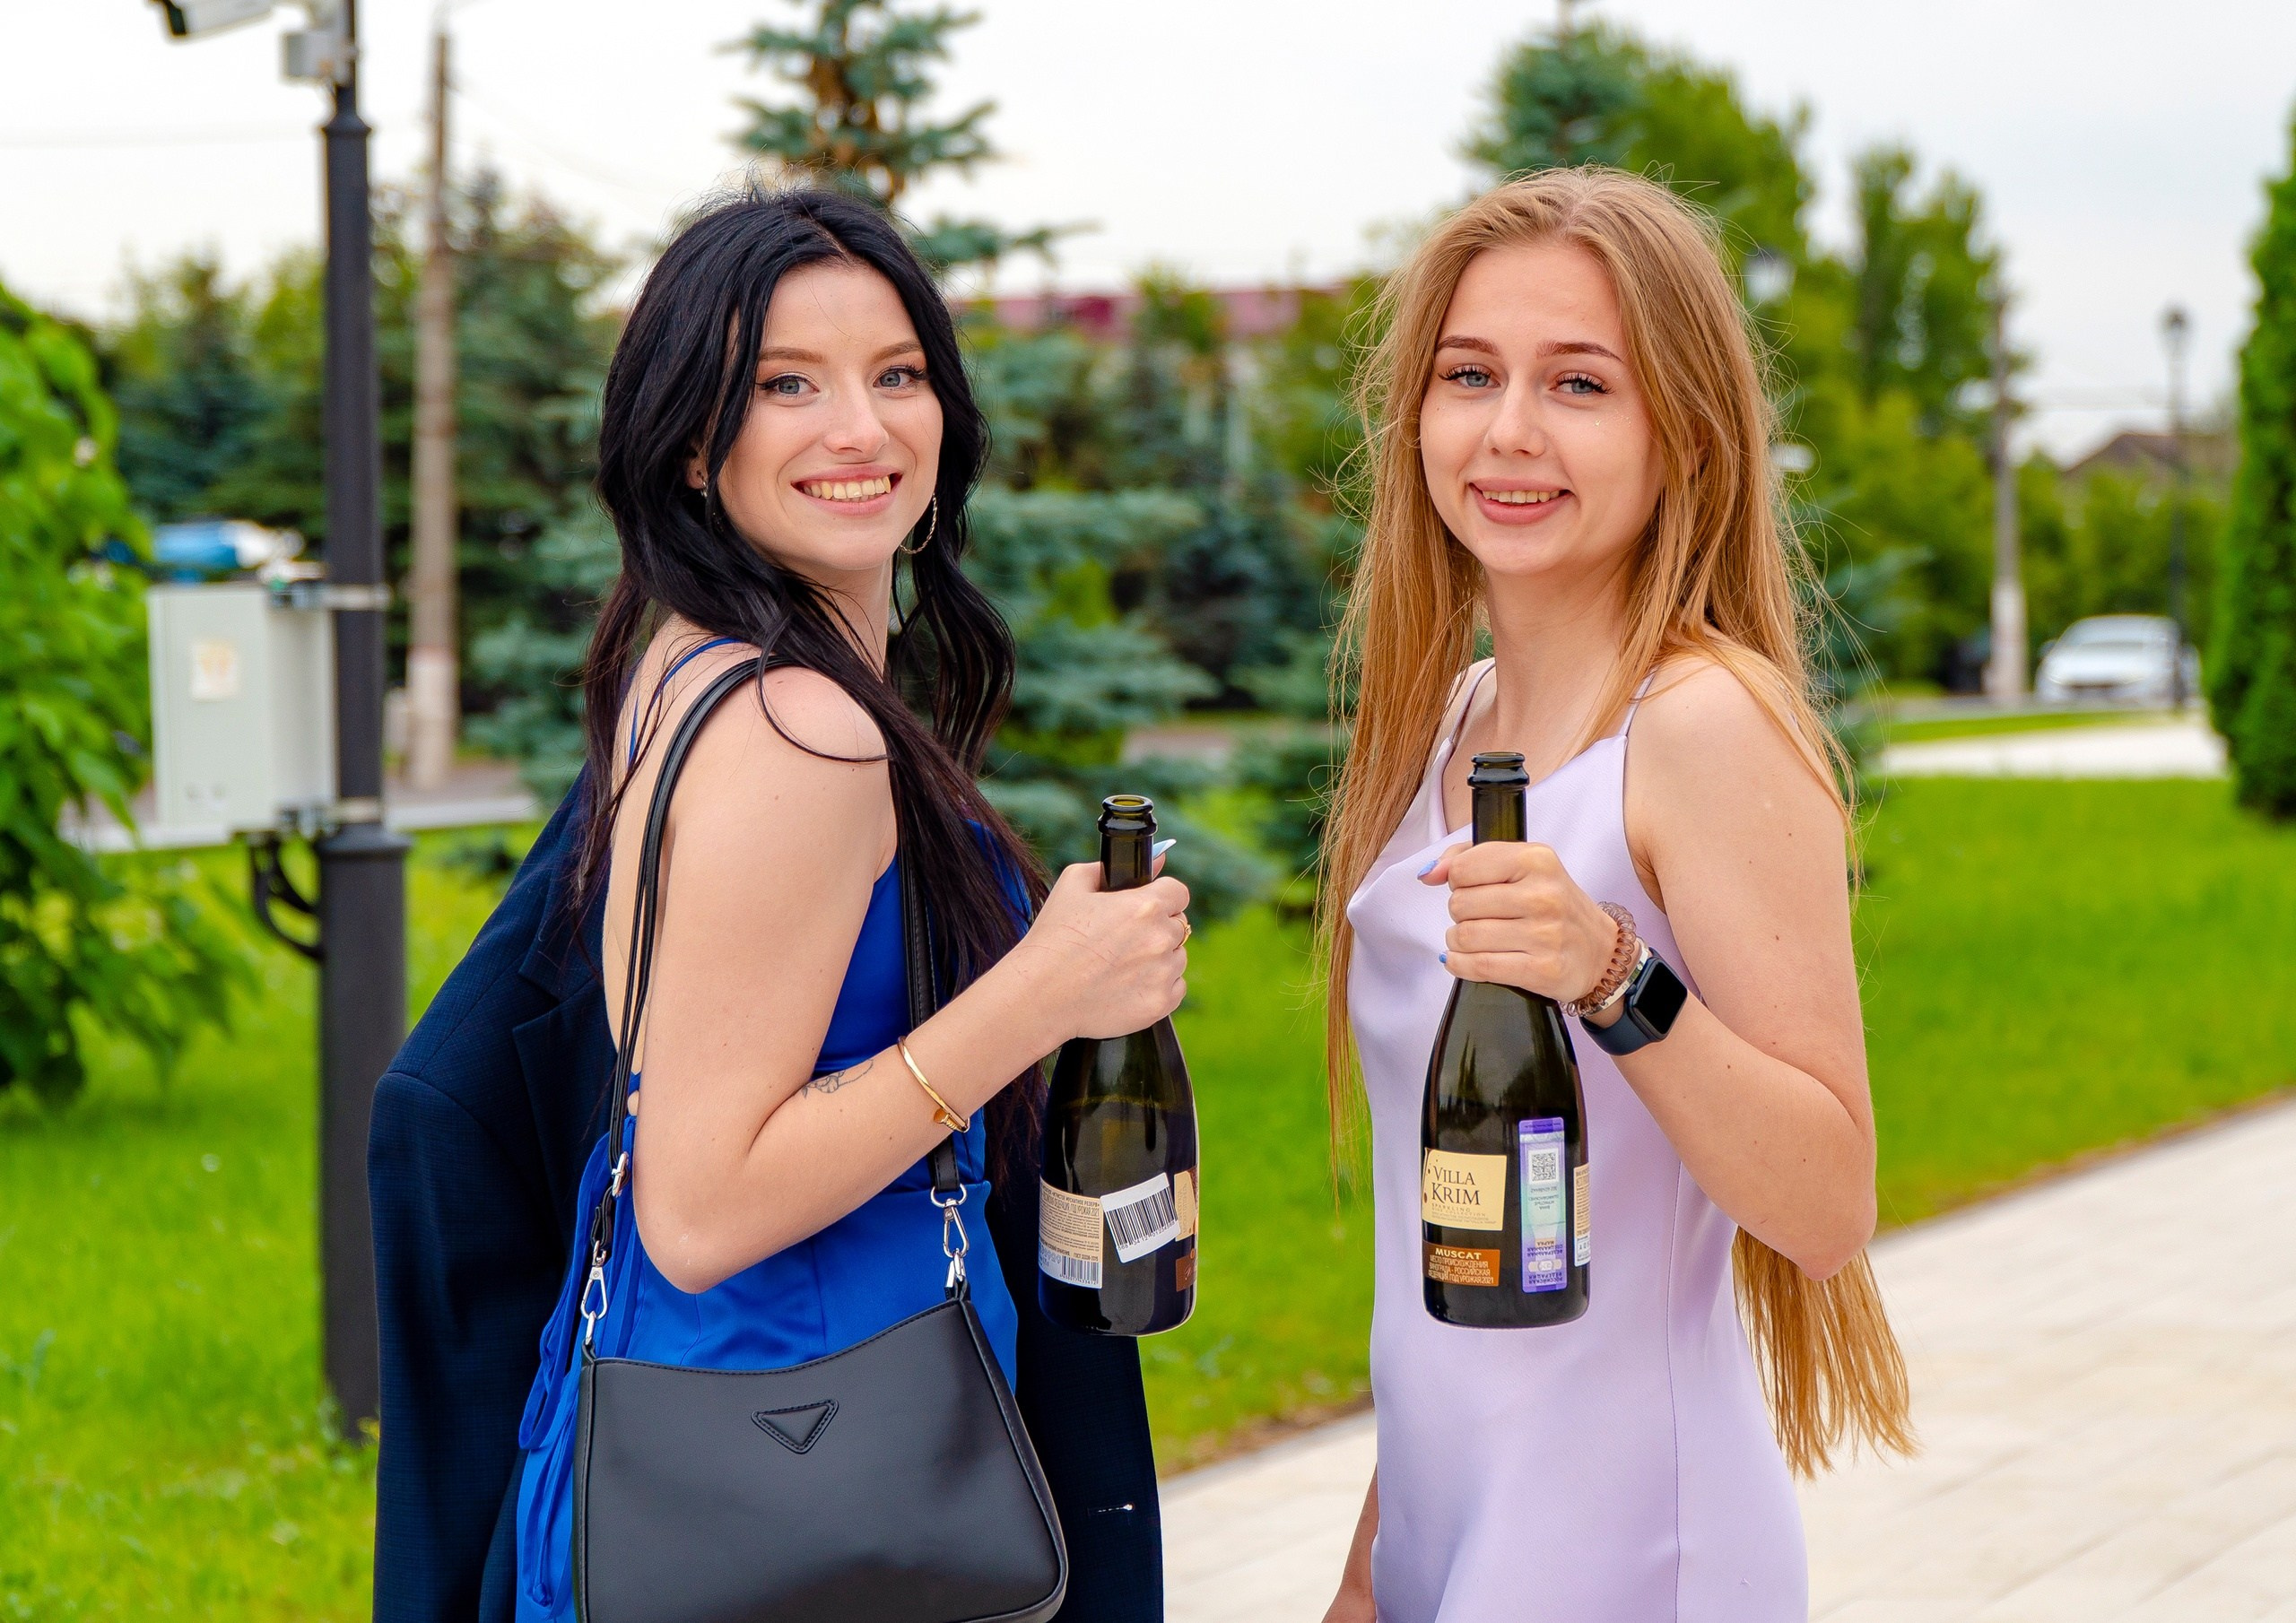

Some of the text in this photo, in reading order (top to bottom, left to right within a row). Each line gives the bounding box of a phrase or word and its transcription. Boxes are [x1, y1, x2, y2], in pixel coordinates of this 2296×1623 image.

[1433, 1166, 1475, 1185] VILLA
[1432, 1183, 1480, 1205] KRIM
[1435, 1248, 1482, 1260] MUSCAT
